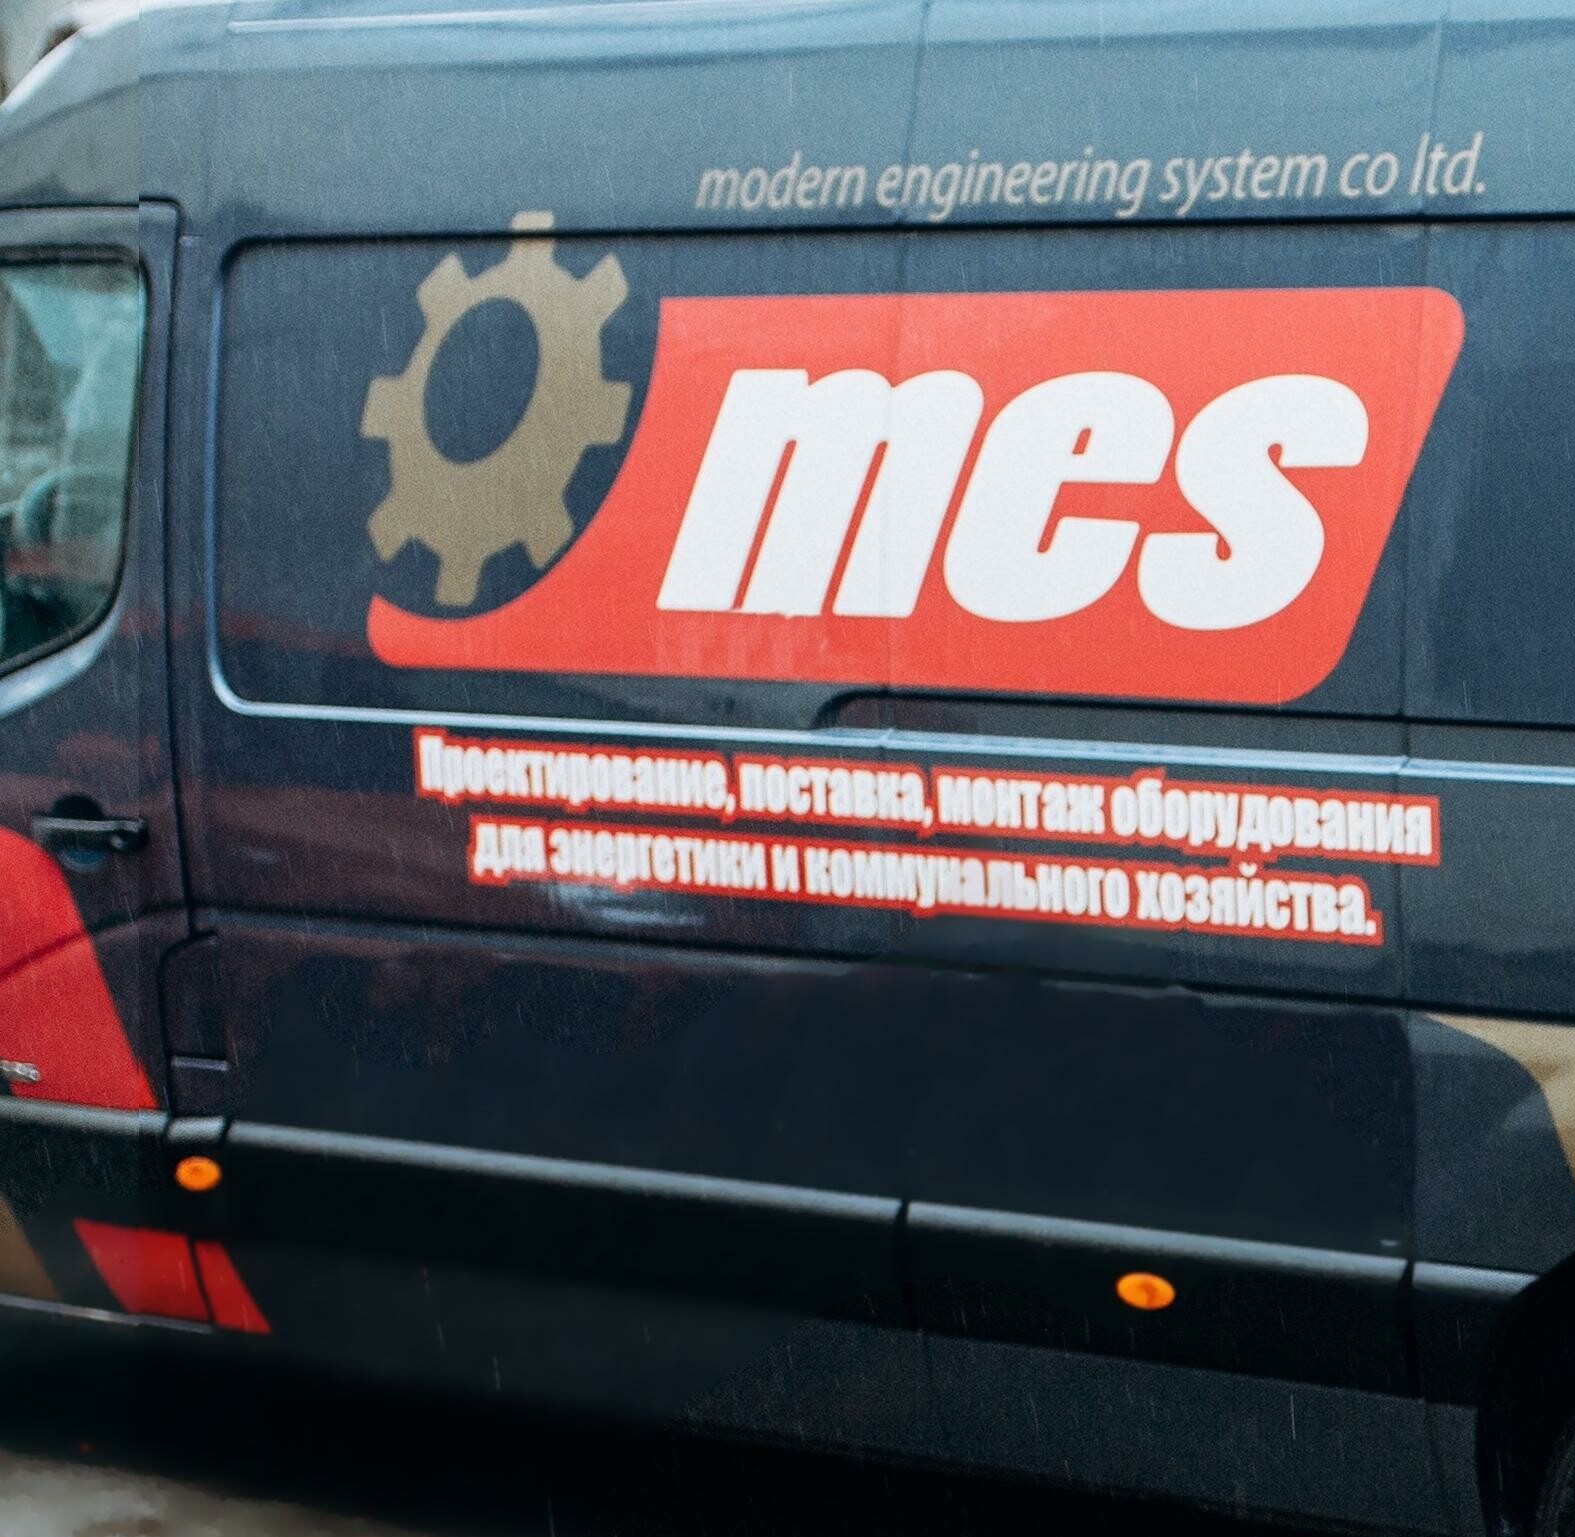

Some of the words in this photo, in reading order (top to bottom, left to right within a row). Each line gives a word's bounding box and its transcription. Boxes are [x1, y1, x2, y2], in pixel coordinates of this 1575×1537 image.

[696, 149, 867, 212] modern
[876, 145, 1152, 222] engineering
[1159, 148, 1328, 218] system
[1339, 152, 1399, 197] co
[1408, 131, 1487, 197] ltd.
[656, 367, 1370, 630] mes
[418, 734, 736, 815] Проектирование,
[738, 762, 933, 828] поставка,
[937, 774, 1105, 835] монтаж
[1110, 777, 1433, 857] оборудования
[473, 822, 546, 878] для
[549, 828, 768, 891] энергетики
[771, 843, 800, 893] и
[804, 846, 1130, 919] коммунального
[1135, 861, 1378, 938] хозяйства.
